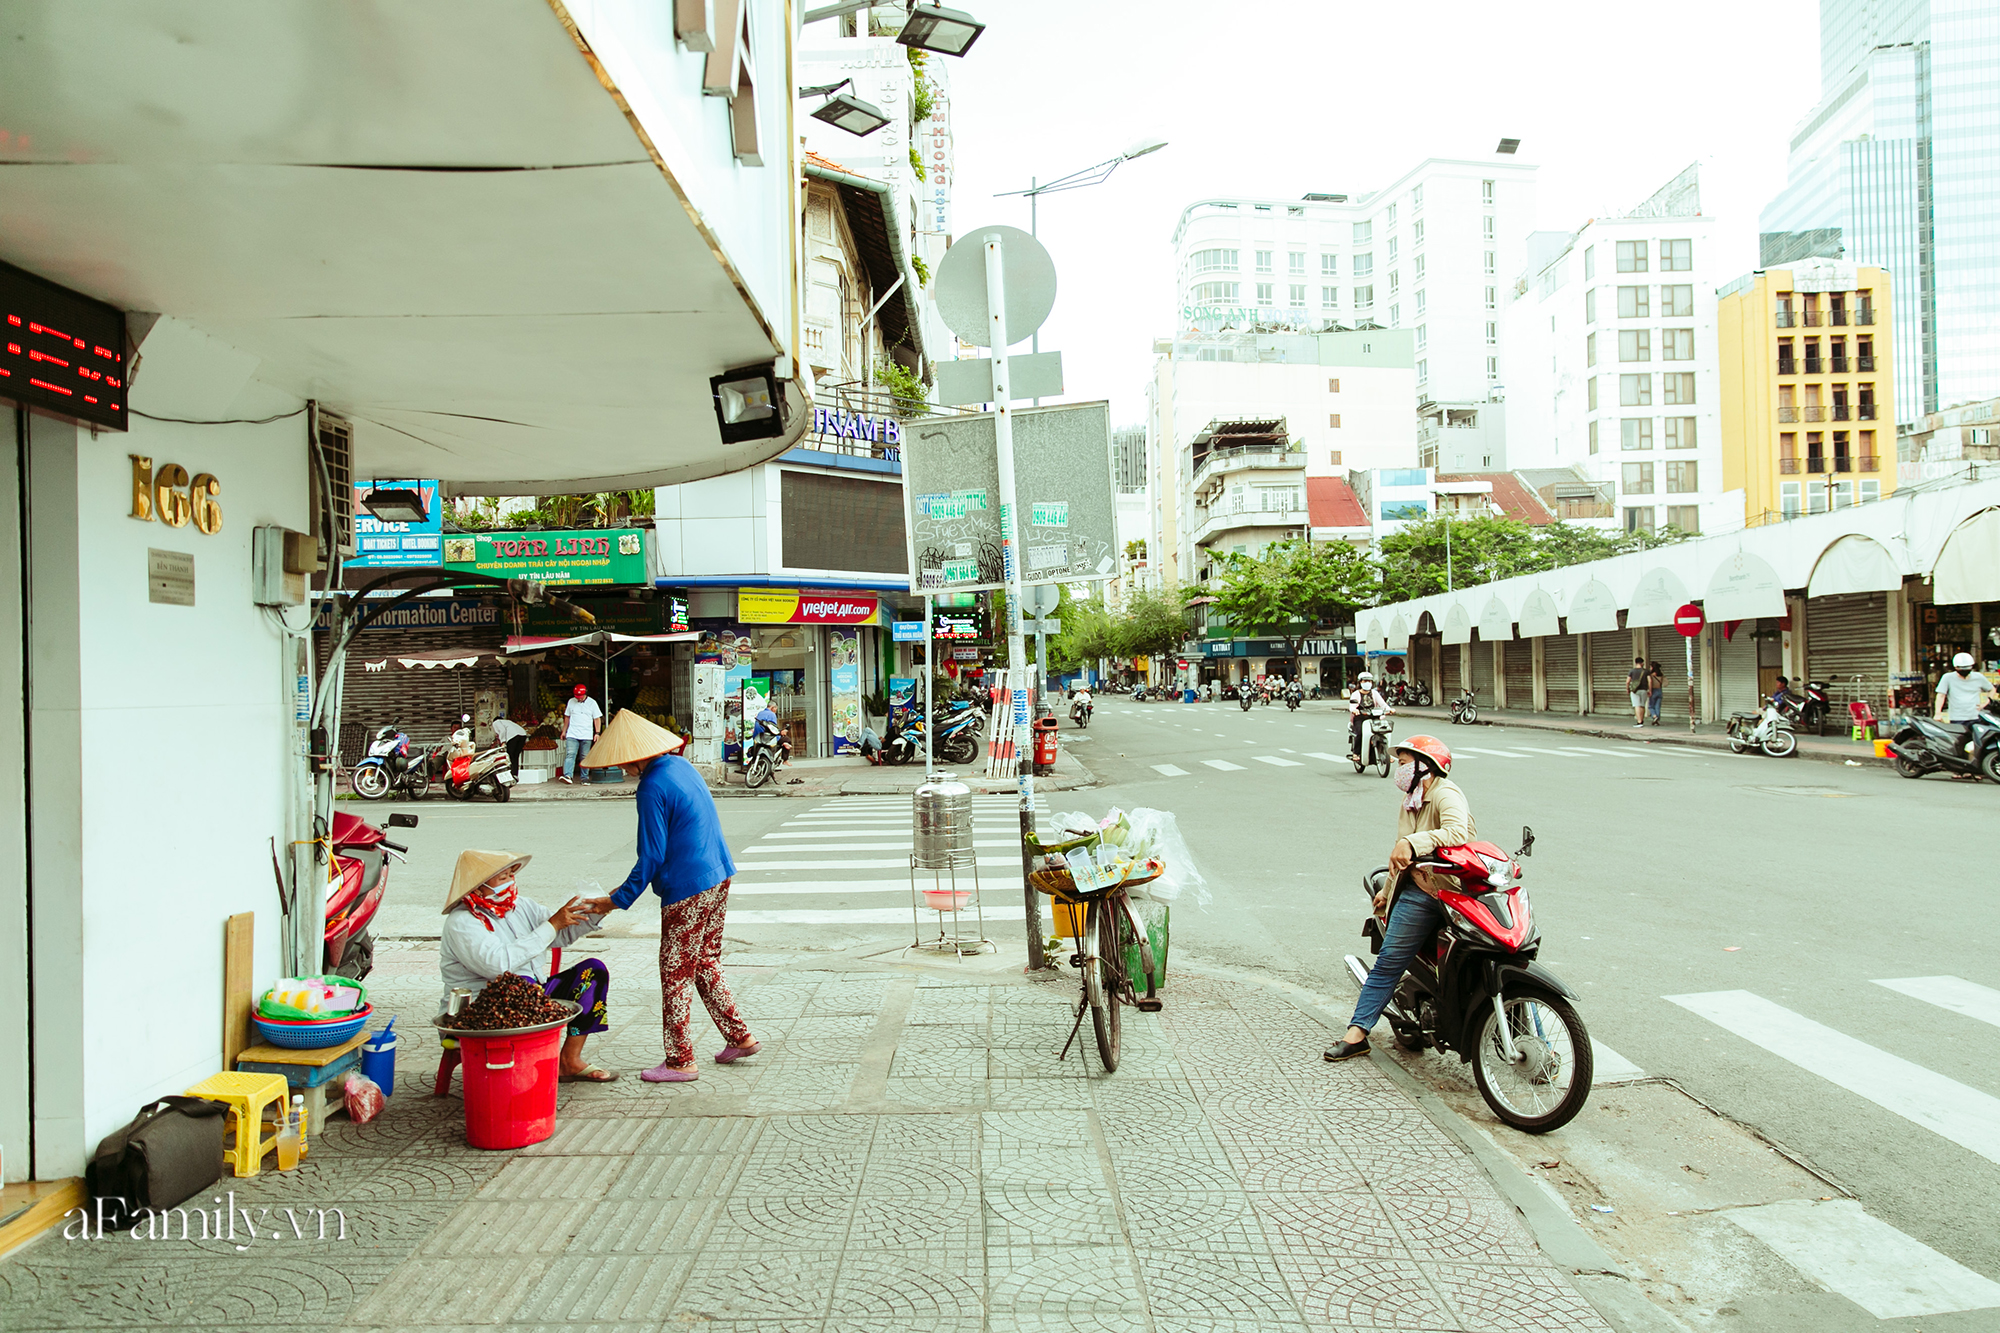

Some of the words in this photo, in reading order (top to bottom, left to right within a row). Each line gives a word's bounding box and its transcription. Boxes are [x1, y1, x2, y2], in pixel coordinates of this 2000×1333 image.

[1183, 306, 1222, 320] SONG
[1227, 308, 1259, 322] ANH
[883, 418, 900, 444] B
[127, 454, 224, 535] 166
[355, 519, 410, 533] ERVICE
[377, 538, 396, 549] TICKETS
[476, 535, 492, 543] Shop
[491, 535, 549, 558] TOÀN
[476, 561, 502, 570] CHUYÊN
[504, 561, 526, 569] DOANH
[545, 559, 557, 567] CÂY
[558, 559, 570, 568] NỘI
[571, 559, 591, 567] NGOẠI
[592, 558, 610, 567] NHẬP
[1047, 567, 1071, 576] OPTONE
[450, 602, 498, 624] Center
[1212, 643, 1231, 652] KATINAT
